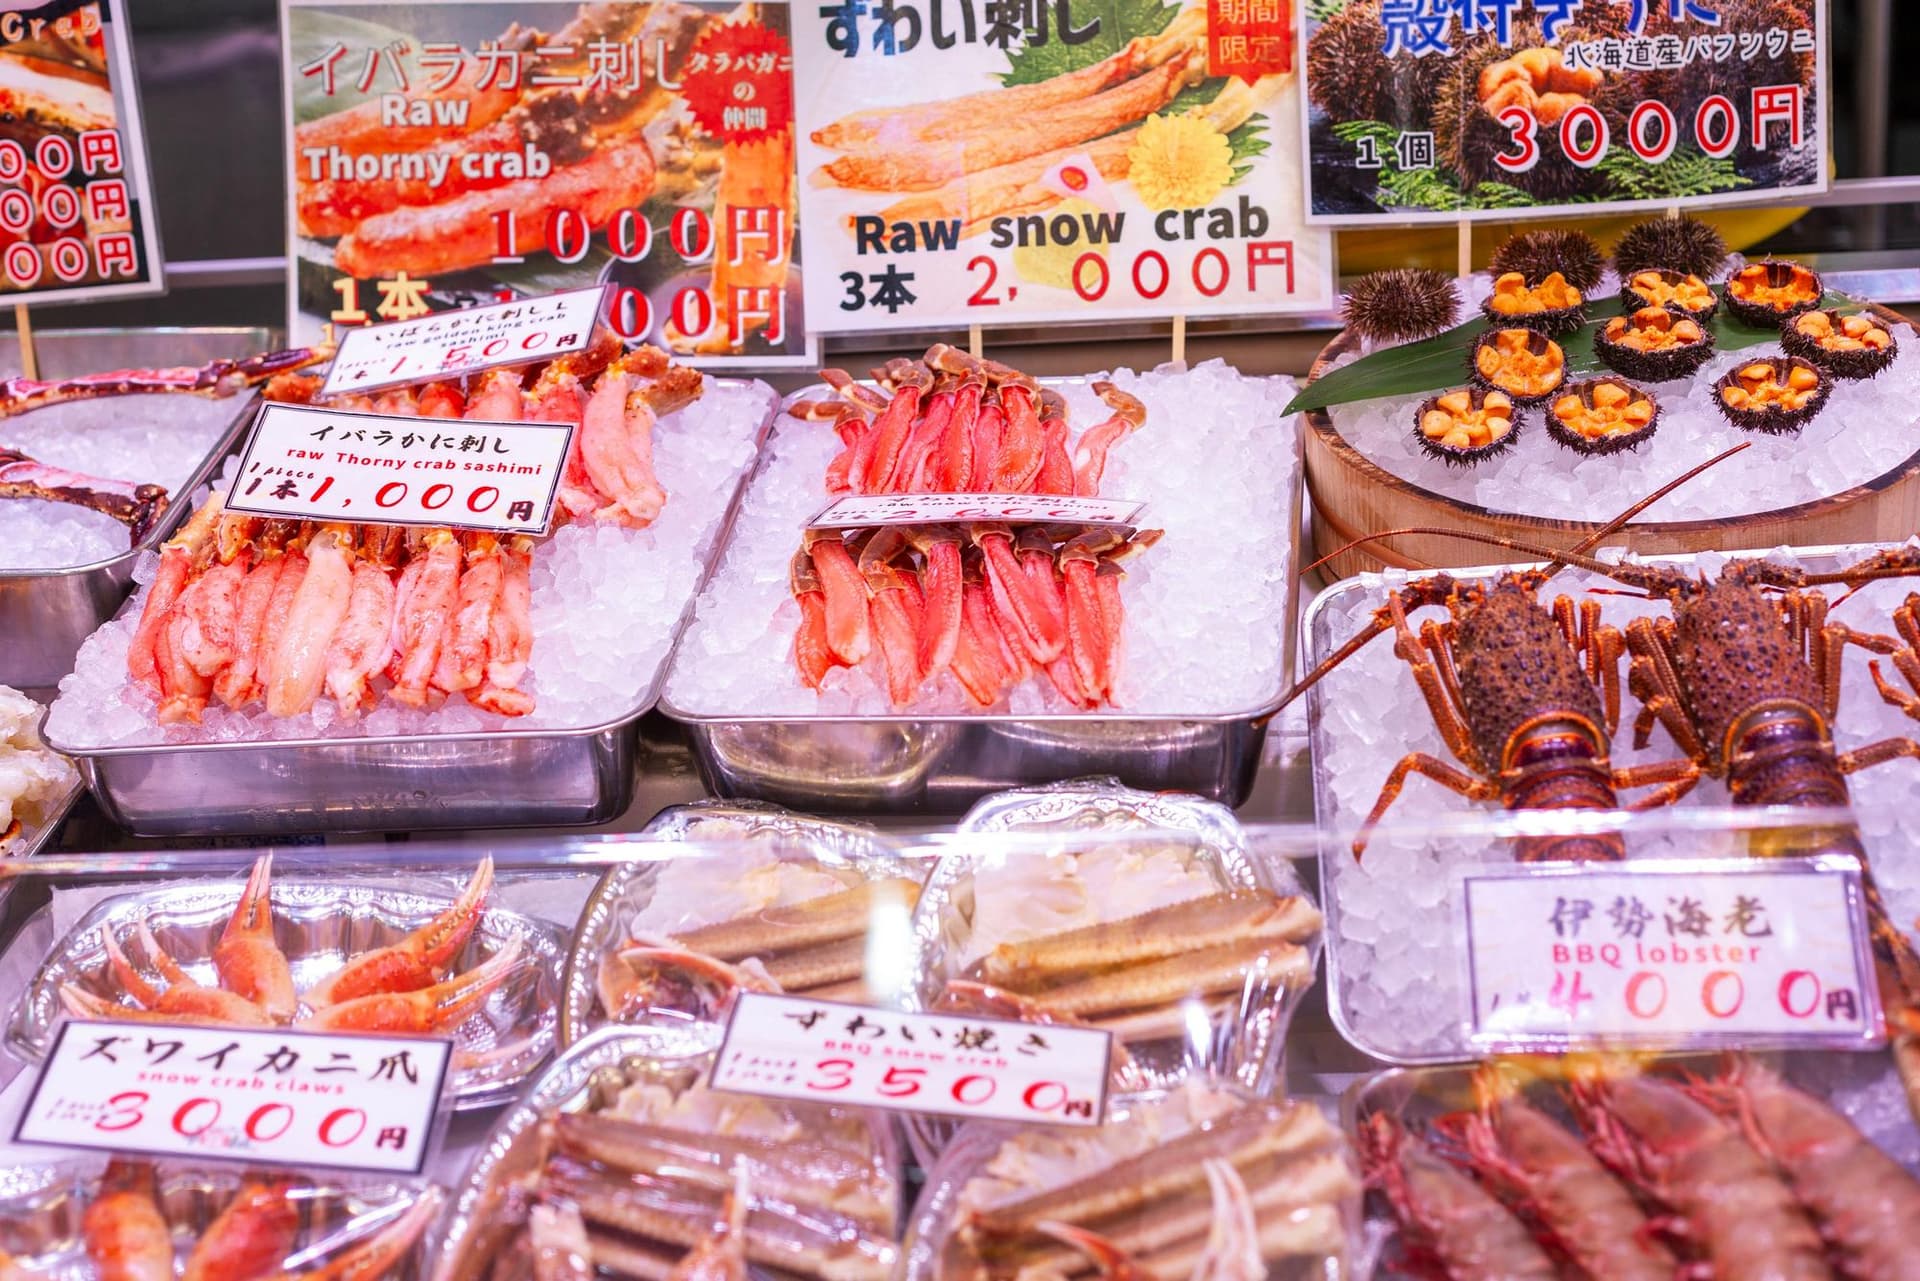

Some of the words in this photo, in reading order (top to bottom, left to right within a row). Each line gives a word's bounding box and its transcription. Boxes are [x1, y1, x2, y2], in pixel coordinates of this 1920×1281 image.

[1, 2, 101, 42] Crab
[301, 37, 684, 94] イバラカニ刺し
[1219, 34, 1280, 64] 限定
[1564, 31, 1813, 69] 北海道産バフンウニ
[733, 81, 756, 102] の
[381, 95, 470, 129] Raw
[723, 107, 767, 131] 仲間
[1494, 85, 1802, 172] 3000円
[304, 147, 456, 187] Thorny
[460, 143, 551, 180] crab
[855, 213, 961, 255] Raw
[990, 211, 1127, 249] snow
[1153, 194, 1270, 242] crab
[330, 271, 432, 322] 1本
[839, 263, 918, 315] 3本
[386, 338, 417, 350] raw
[422, 328, 483, 345] golden
[487, 319, 523, 334] king
[529, 312, 567, 326] crab
[440, 331, 506, 349] sashimi
[309, 425, 510, 454] イバラかに刺し
[287, 447, 324, 461] raw
[336, 452, 406, 470] Thorny
[413, 457, 456, 471] crab
[463, 462, 542, 476] sashimi
[1548, 895, 1774, 938] 伊勢海老
[1552, 944, 1622, 968] BBQ
[1636, 943, 1763, 964] lobster
[80, 1034, 419, 1085] ズワイカニ爪
[136, 1070, 201, 1086] snow
[210, 1073, 265, 1090] crab
[274, 1077, 345, 1096] claws
